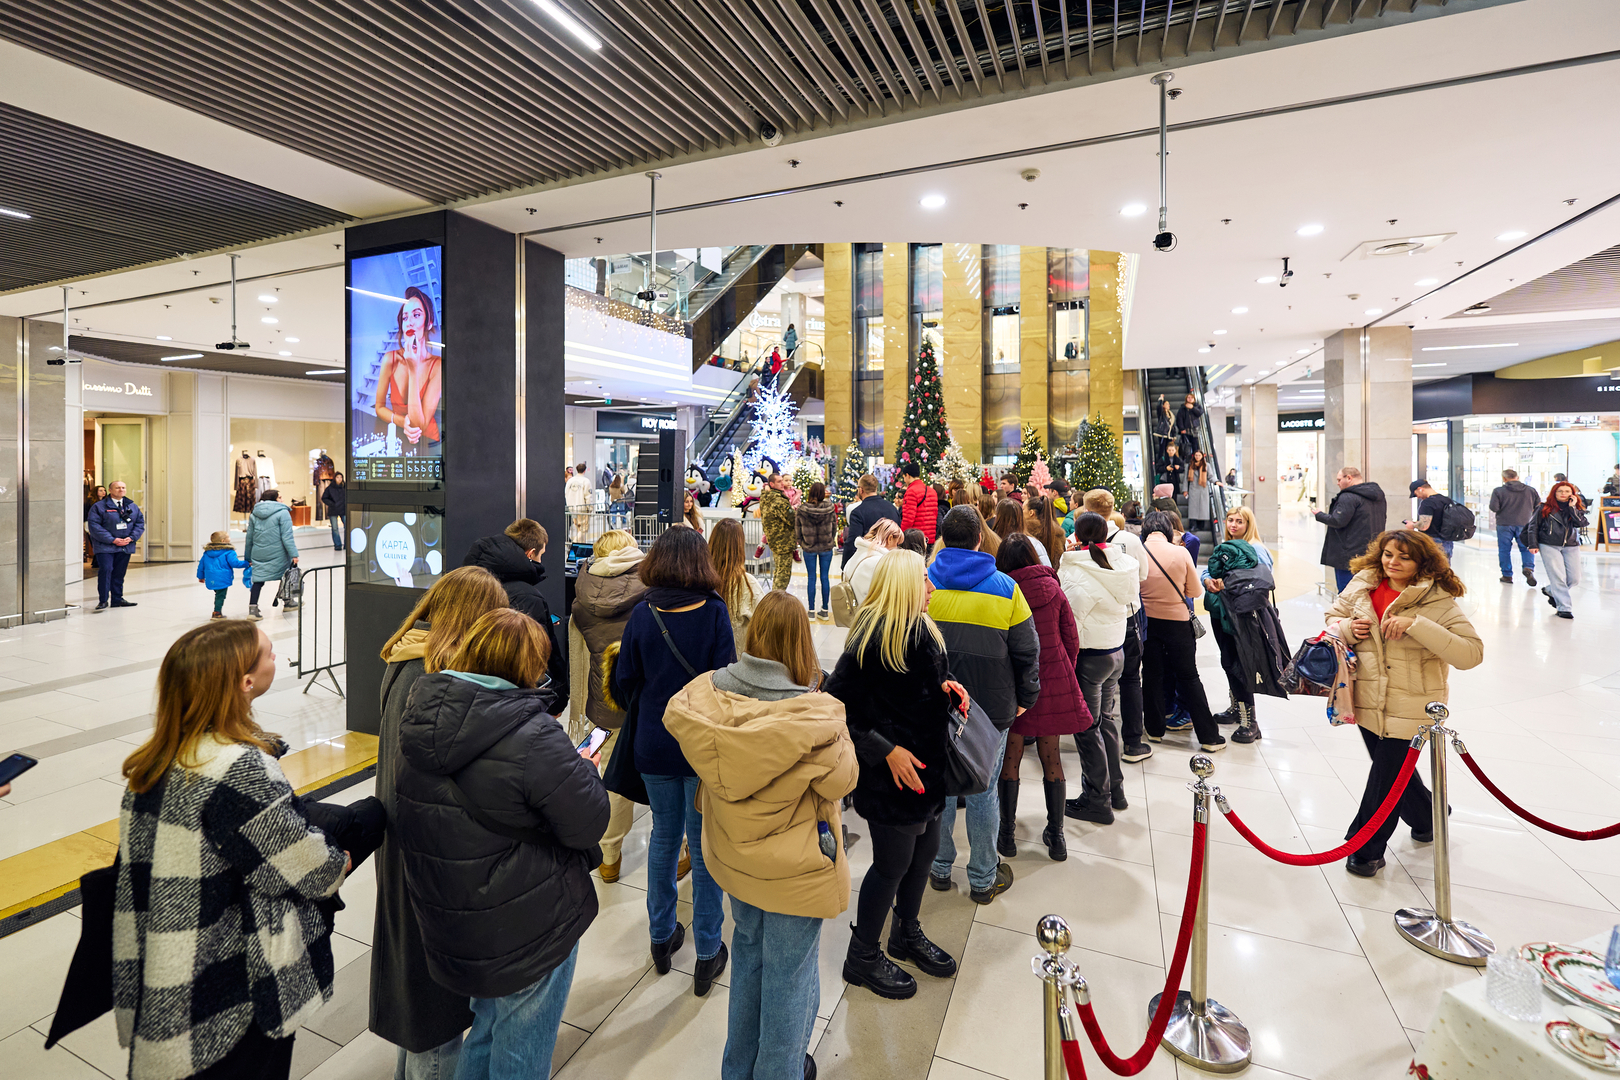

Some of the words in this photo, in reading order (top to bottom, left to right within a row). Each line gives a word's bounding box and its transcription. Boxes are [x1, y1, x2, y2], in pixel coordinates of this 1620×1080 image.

[124, 382, 153, 396] Dutti
[641, 417, 658, 429] ROY
[1281, 420, 1313, 428] LACOSTE
[382, 540, 409, 551] КАРТА
